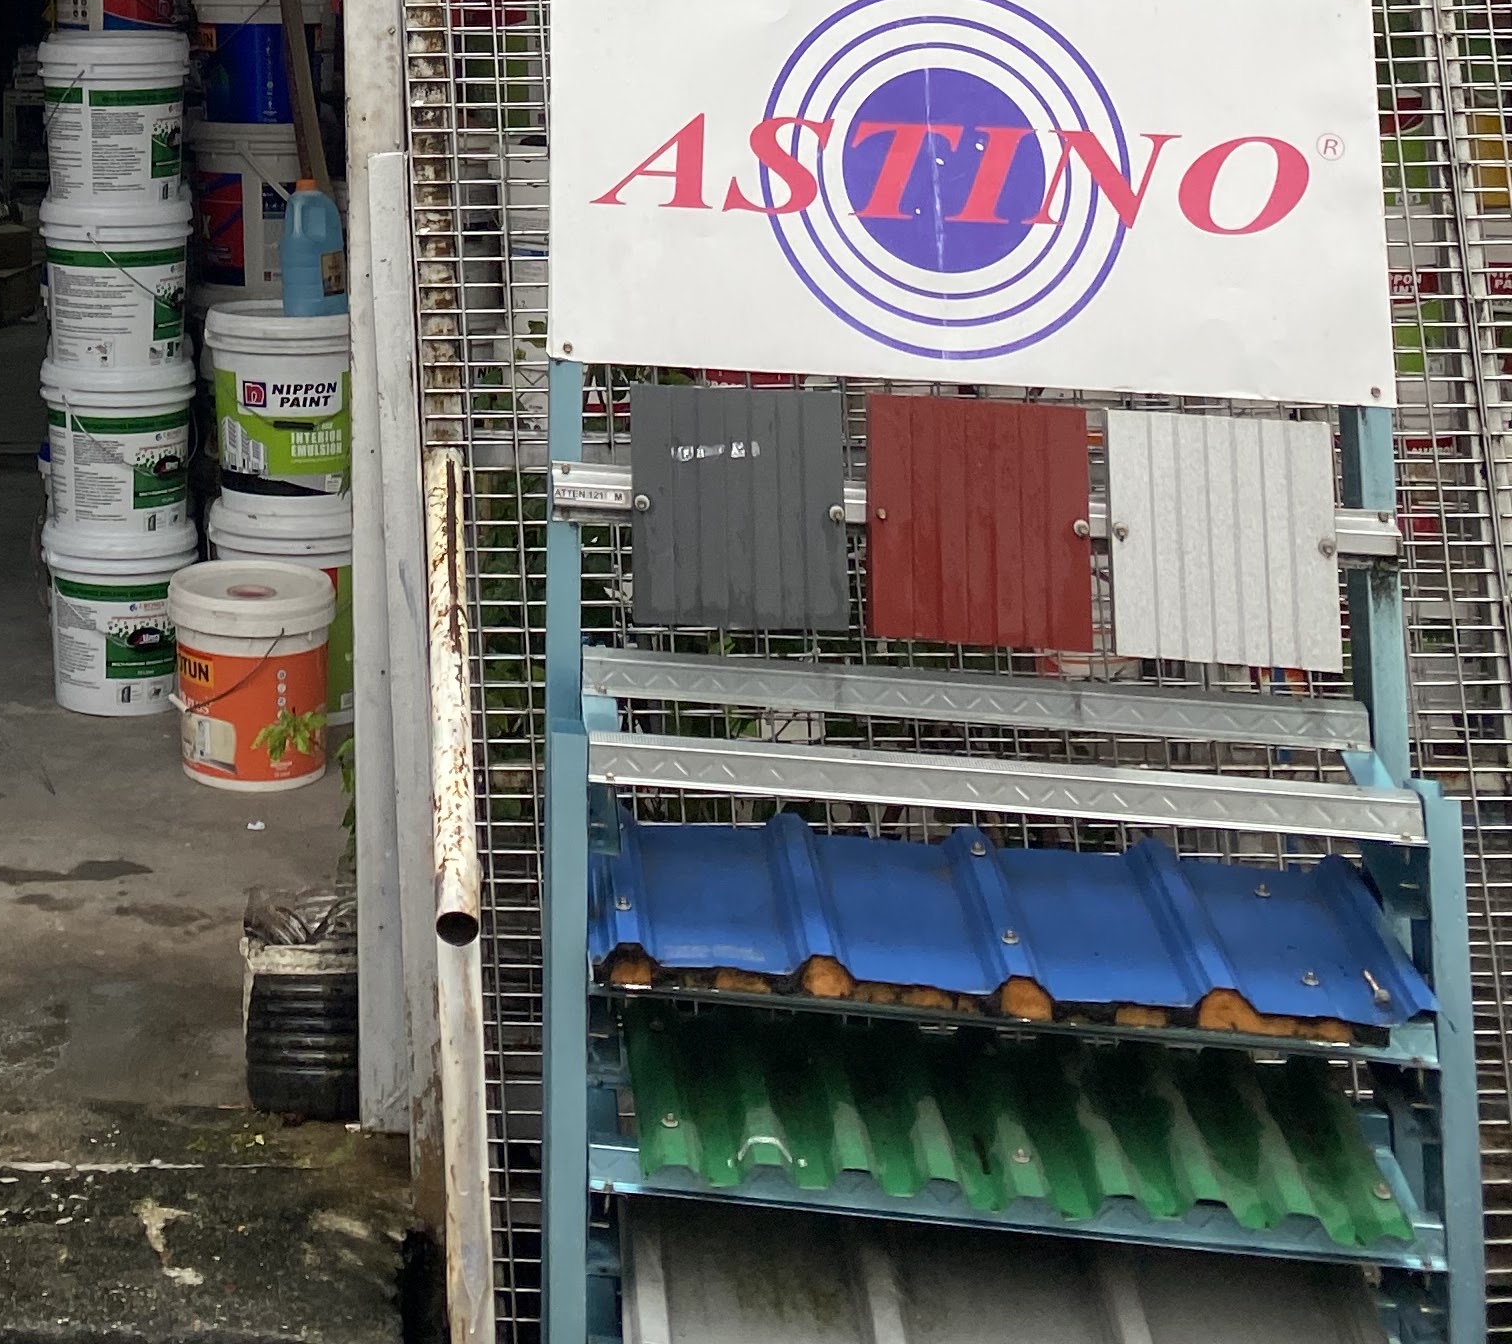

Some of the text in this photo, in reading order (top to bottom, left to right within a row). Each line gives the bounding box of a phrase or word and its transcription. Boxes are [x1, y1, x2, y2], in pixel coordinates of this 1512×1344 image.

[590, 112, 1312, 236] ASTINO
[271, 381, 338, 395] NIPPON
[279, 395, 332, 408] PAINT
[290, 429, 342, 444] INTERIOR
[290, 442, 342, 457] EMULSION
